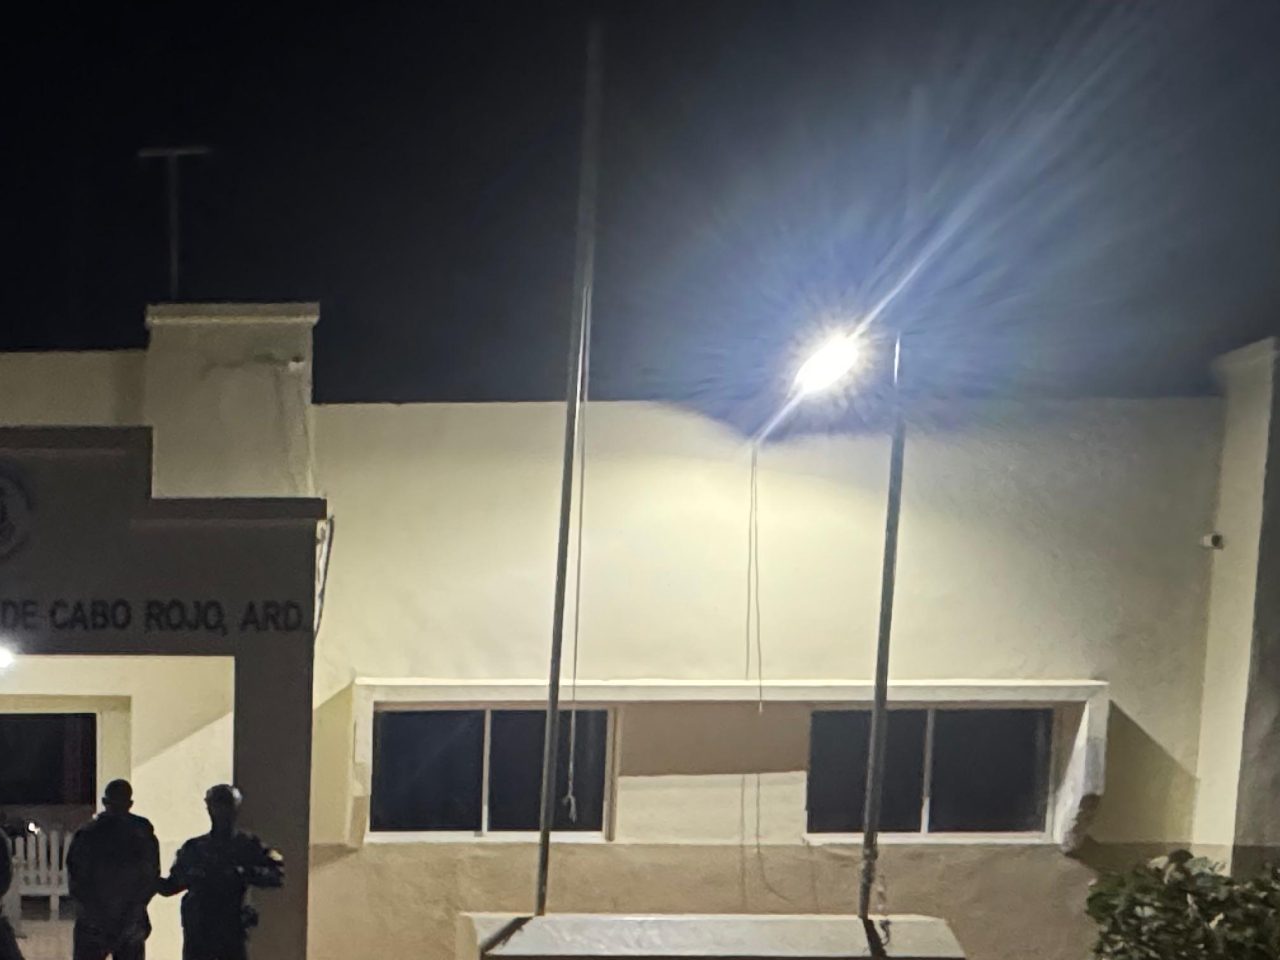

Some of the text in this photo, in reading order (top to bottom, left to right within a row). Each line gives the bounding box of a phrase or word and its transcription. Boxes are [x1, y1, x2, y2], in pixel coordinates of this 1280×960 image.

[1, 599, 39, 629] DE
[49, 598, 132, 630] CABO
[144, 598, 227, 635] ROJO,
